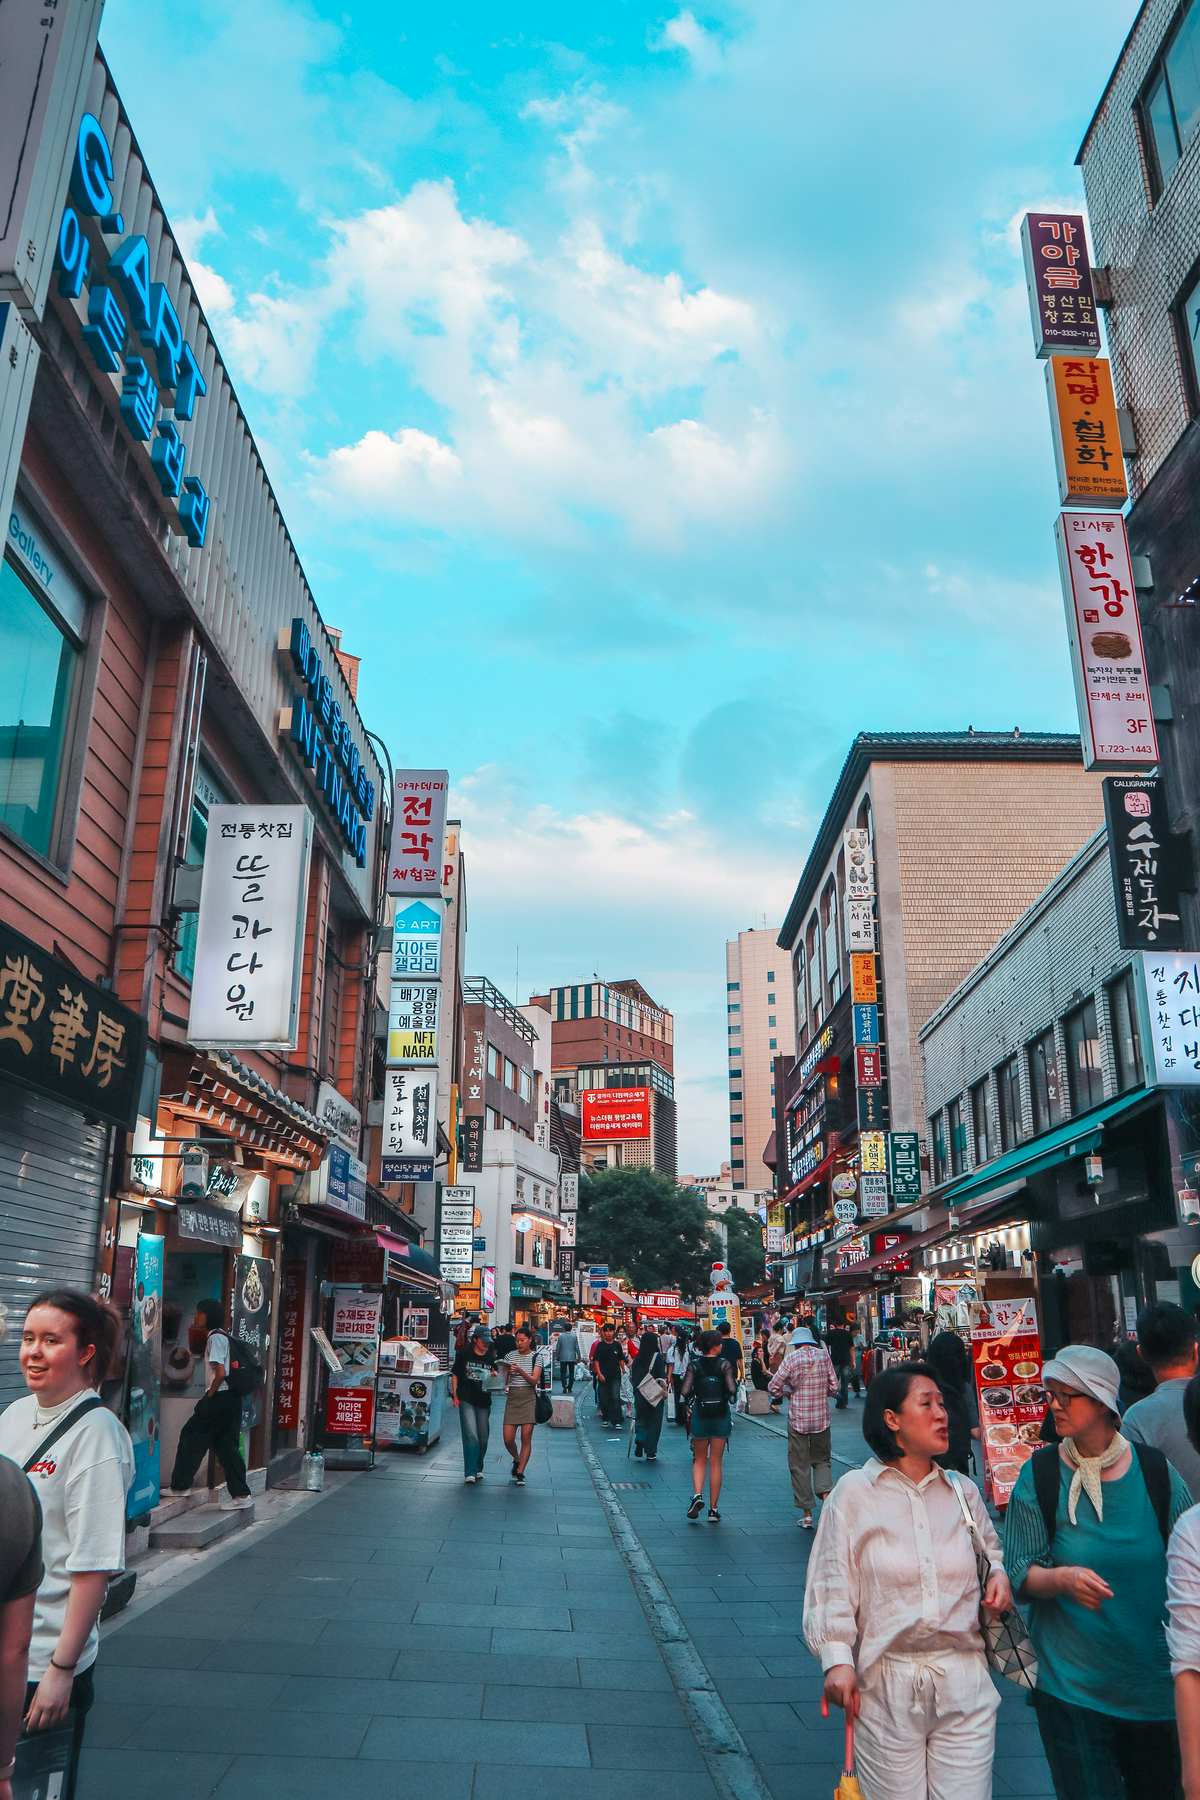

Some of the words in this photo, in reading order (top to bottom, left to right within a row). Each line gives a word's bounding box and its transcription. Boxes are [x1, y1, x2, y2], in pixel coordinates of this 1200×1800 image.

[1072, 520, 1116, 532] 인사동
[9, 513, 53, 587] Gallery
[1074, 542, 1130, 618] 한강
[1090, 692, 1121, 702] 단체석
[1124, 692, 1146, 702] 완비
[1126, 718, 1148, 734] 3F
[293, 696, 332, 790] NFT
[325, 762, 367, 868] NARA
[397, 782, 445, 791] 아카데미
[1113, 780, 1157, 788] CALLIGRAPHY
[220, 822, 294, 839] 전통찻집
[401, 796, 434, 862] 전각
[392, 867, 437, 881] 체험관
[442, 864, 454, 886] P
[1126, 821, 1181, 941] 수제도장
[226, 854, 273, 1022] 뜰과다원
[395, 941, 438, 956] 지아트
[395, 957, 438, 973] 갤러리
[400, 988, 437, 1001] 배기열
[412, 1001, 437, 1015] 융합
[398, 1015, 436, 1029] 예술원
[413, 1031, 435, 1044] NFT
[402, 1045, 435, 1058] NARA
[1165, 1058, 1177, 1068] 2F
[468, 1067, 483, 1099] 서호
[388, 1075, 408, 1154] 뜰과다원
[868, 1143, 879, 1171] 생맥주
[336, 1310, 377, 1321] 수제도장
